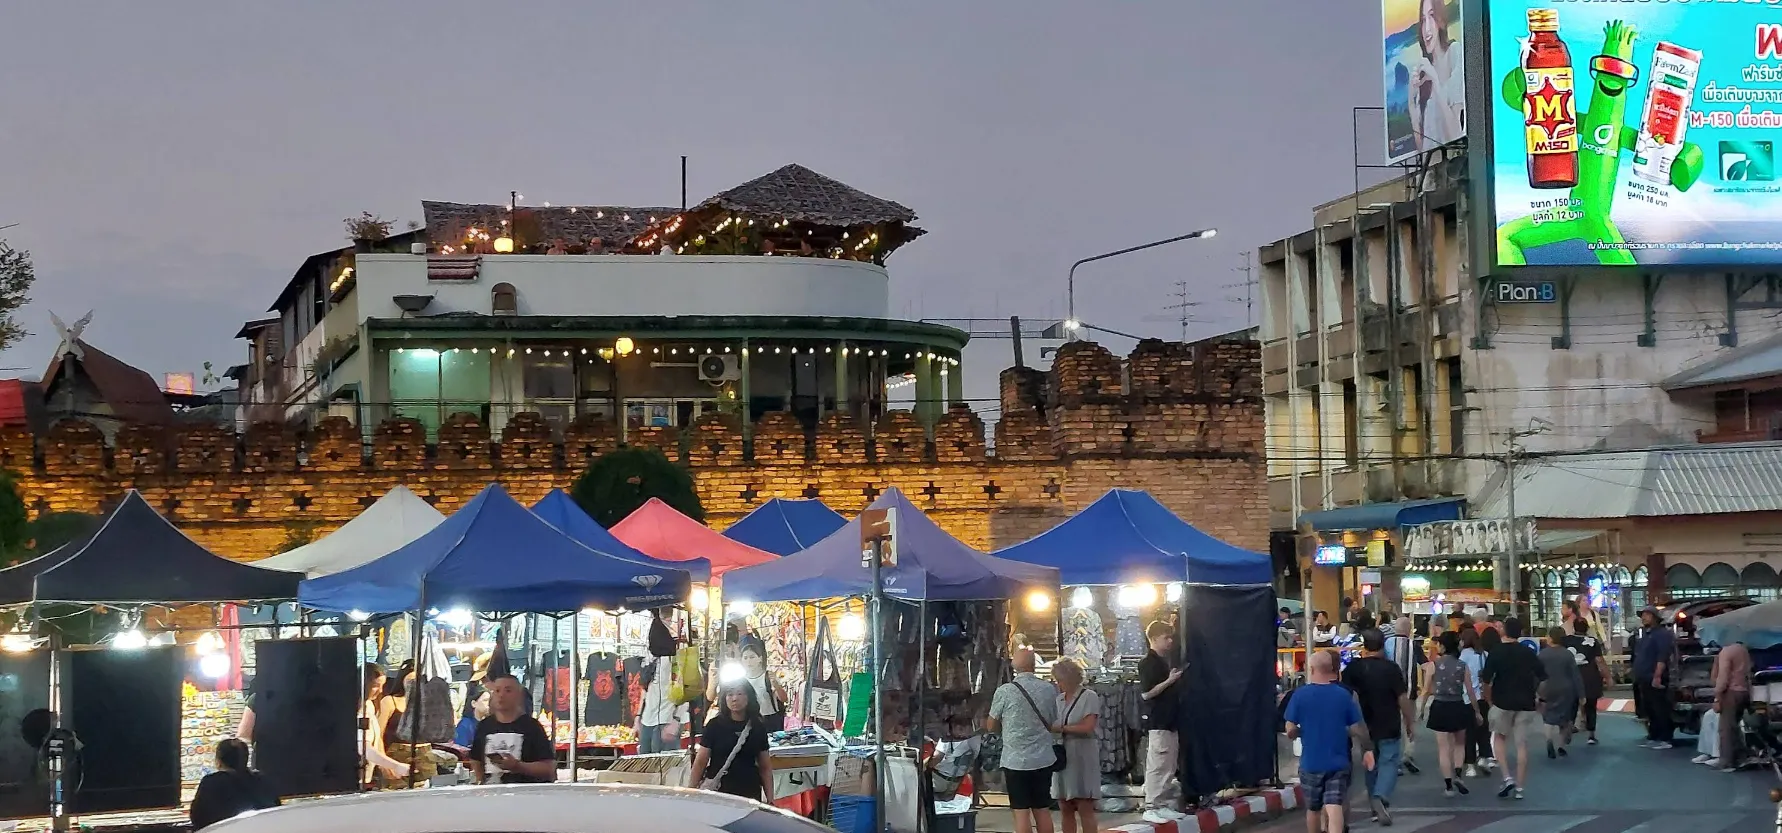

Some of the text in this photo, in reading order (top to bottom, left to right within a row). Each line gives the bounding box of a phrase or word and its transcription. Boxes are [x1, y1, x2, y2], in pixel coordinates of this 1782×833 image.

[1533, 94, 1565, 122] M
[1691, 113, 1732, 126] M-150
[1646, 185, 1659, 195] 250
[1554, 198, 1569, 207] 150
[1557, 210, 1567, 219] 12
